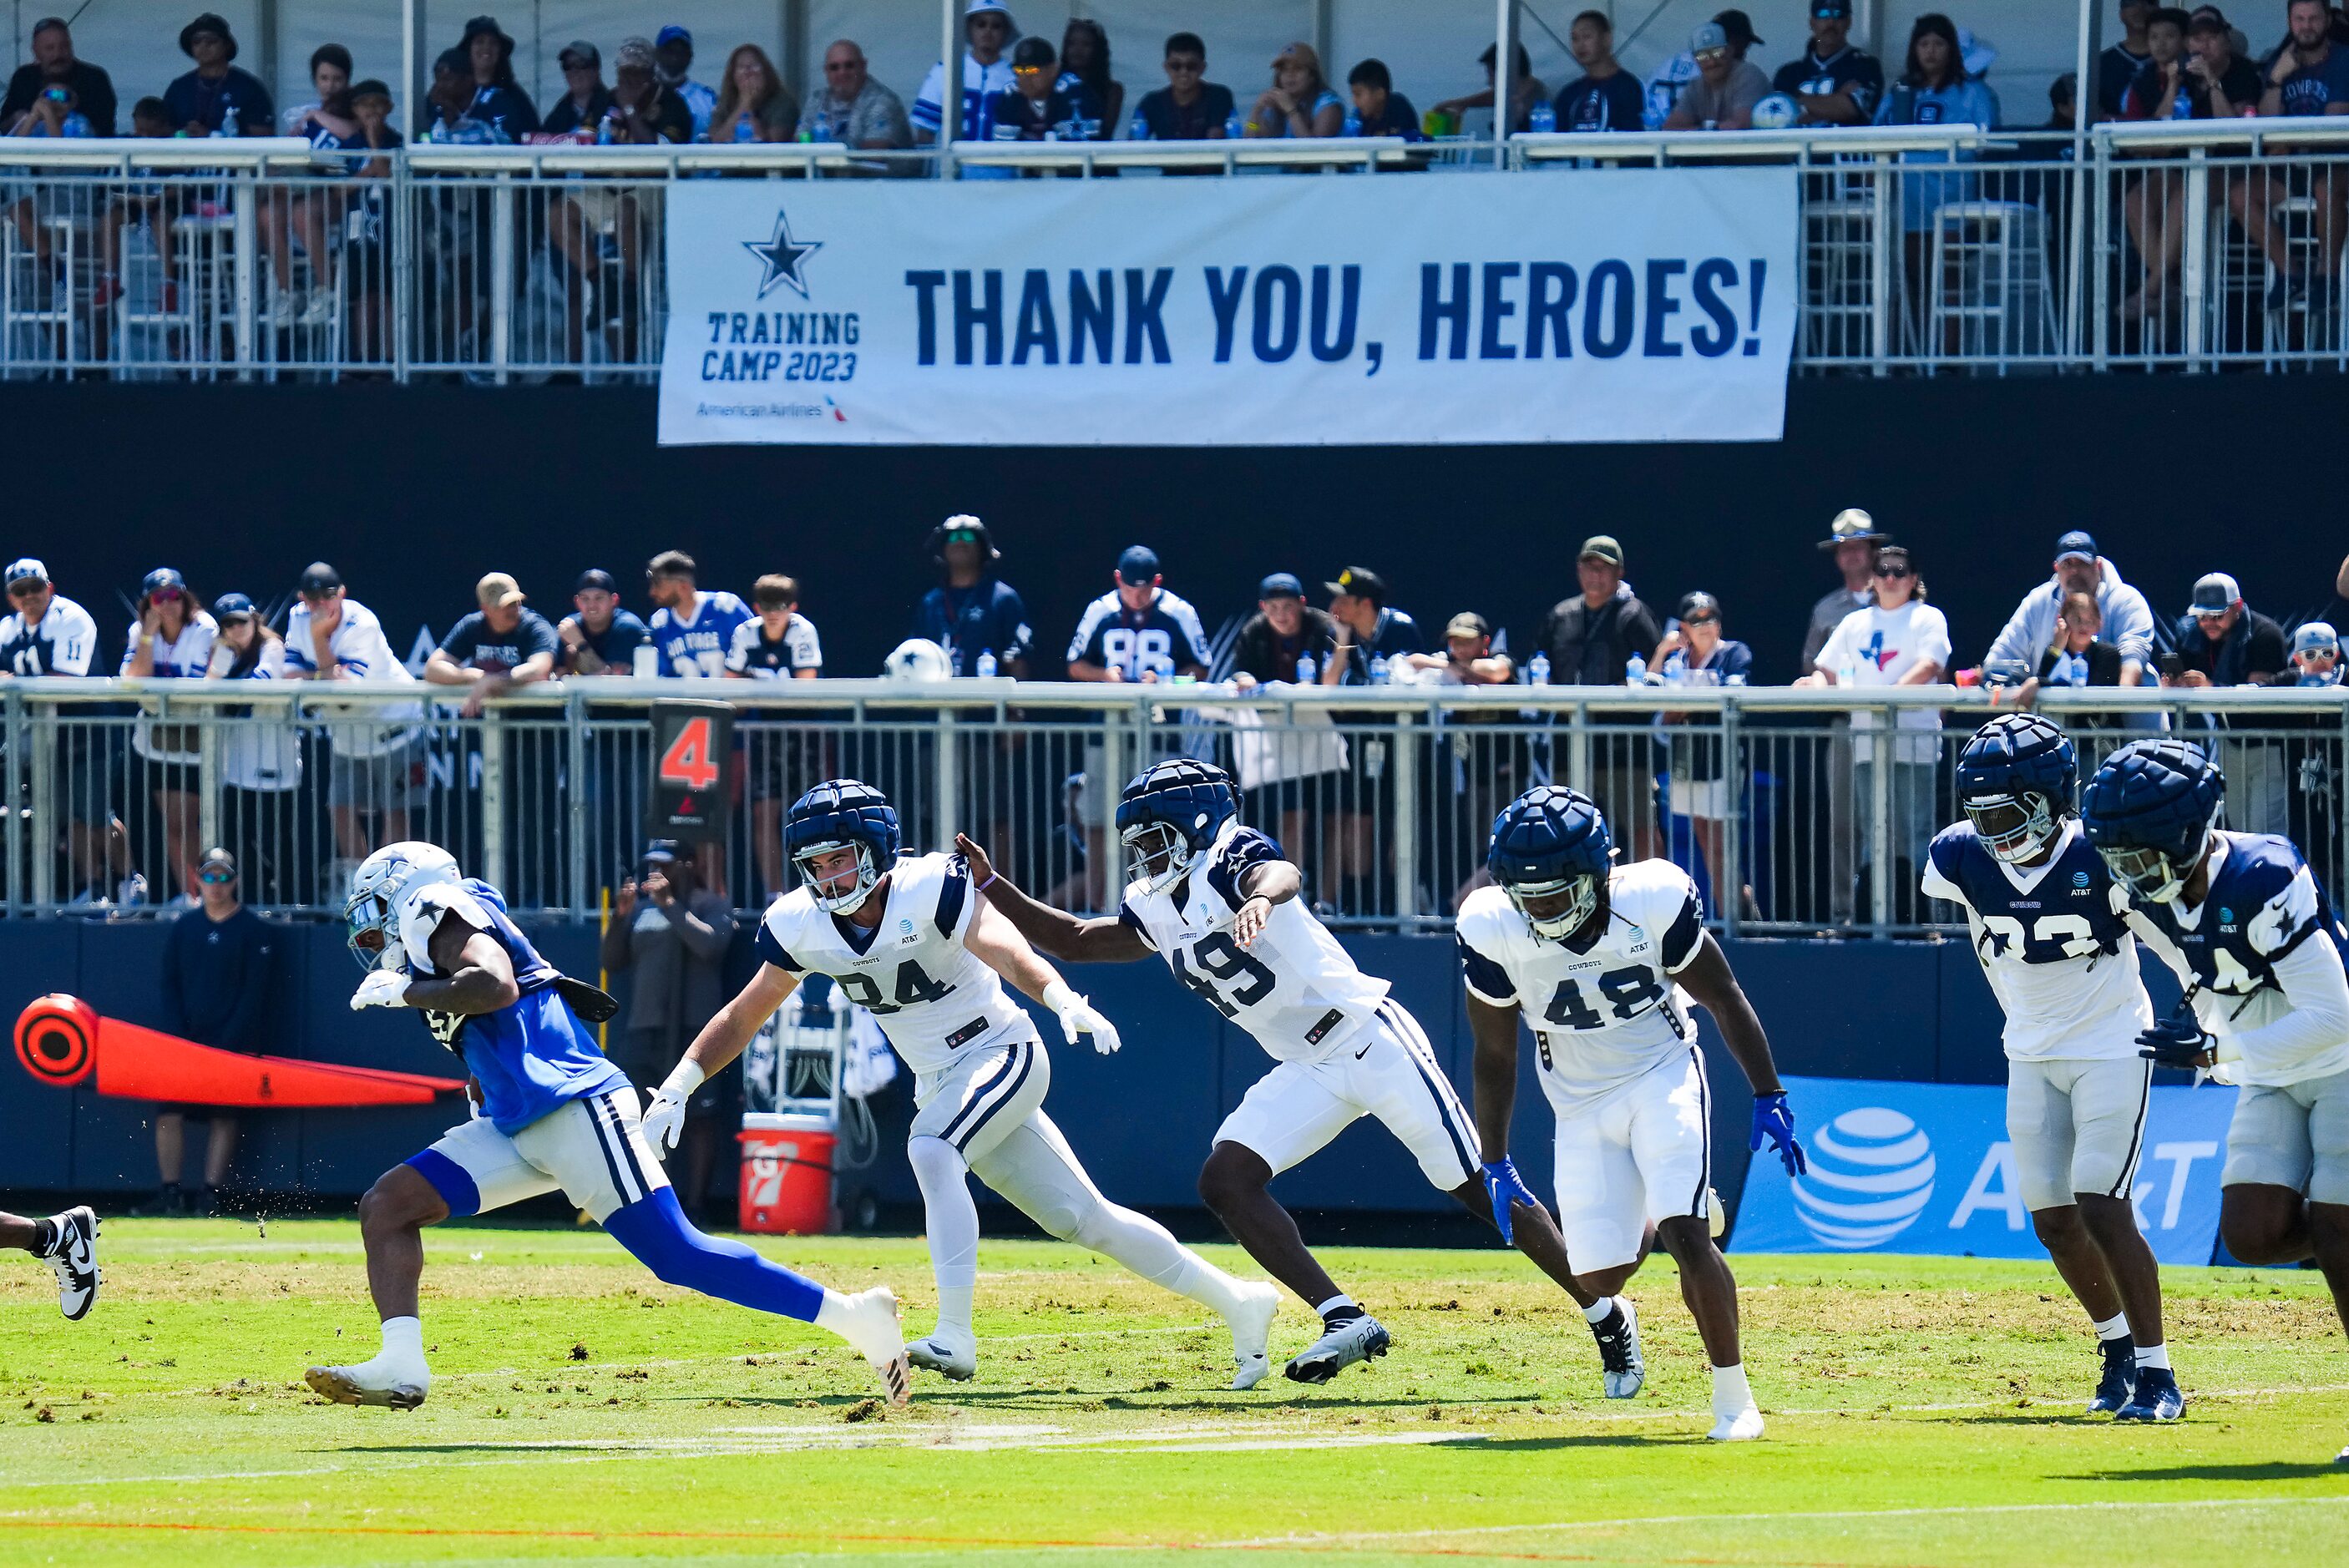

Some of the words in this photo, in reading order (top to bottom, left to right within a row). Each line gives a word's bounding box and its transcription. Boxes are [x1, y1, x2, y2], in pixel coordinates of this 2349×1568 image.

[709, 311, 859, 344] TRAINING
[904, 266, 1174, 366] THANK
[1203, 263, 1383, 377] YOU,
[1417, 257, 1768, 360] HEROES!
[701, 351, 781, 381] CAMP
[784, 352, 857, 381] 2023
[696, 402, 767, 418] American
[770, 402, 822, 417] Airlines
[660, 716, 720, 790] 4
[2070, 888, 2092, 897] AT&T
[902, 934, 919, 945] AT&T
[1630, 942, 1649, 954] AT&T
[852, 957, 880, 967] COWBOYS
[1172, 931, 1276, 1019] 49
[1568, 960, 1602, 971] COWBOYS
[1543, 964, 1665, 1030] 48
[1947, 1141, 2219, 1231] AT
